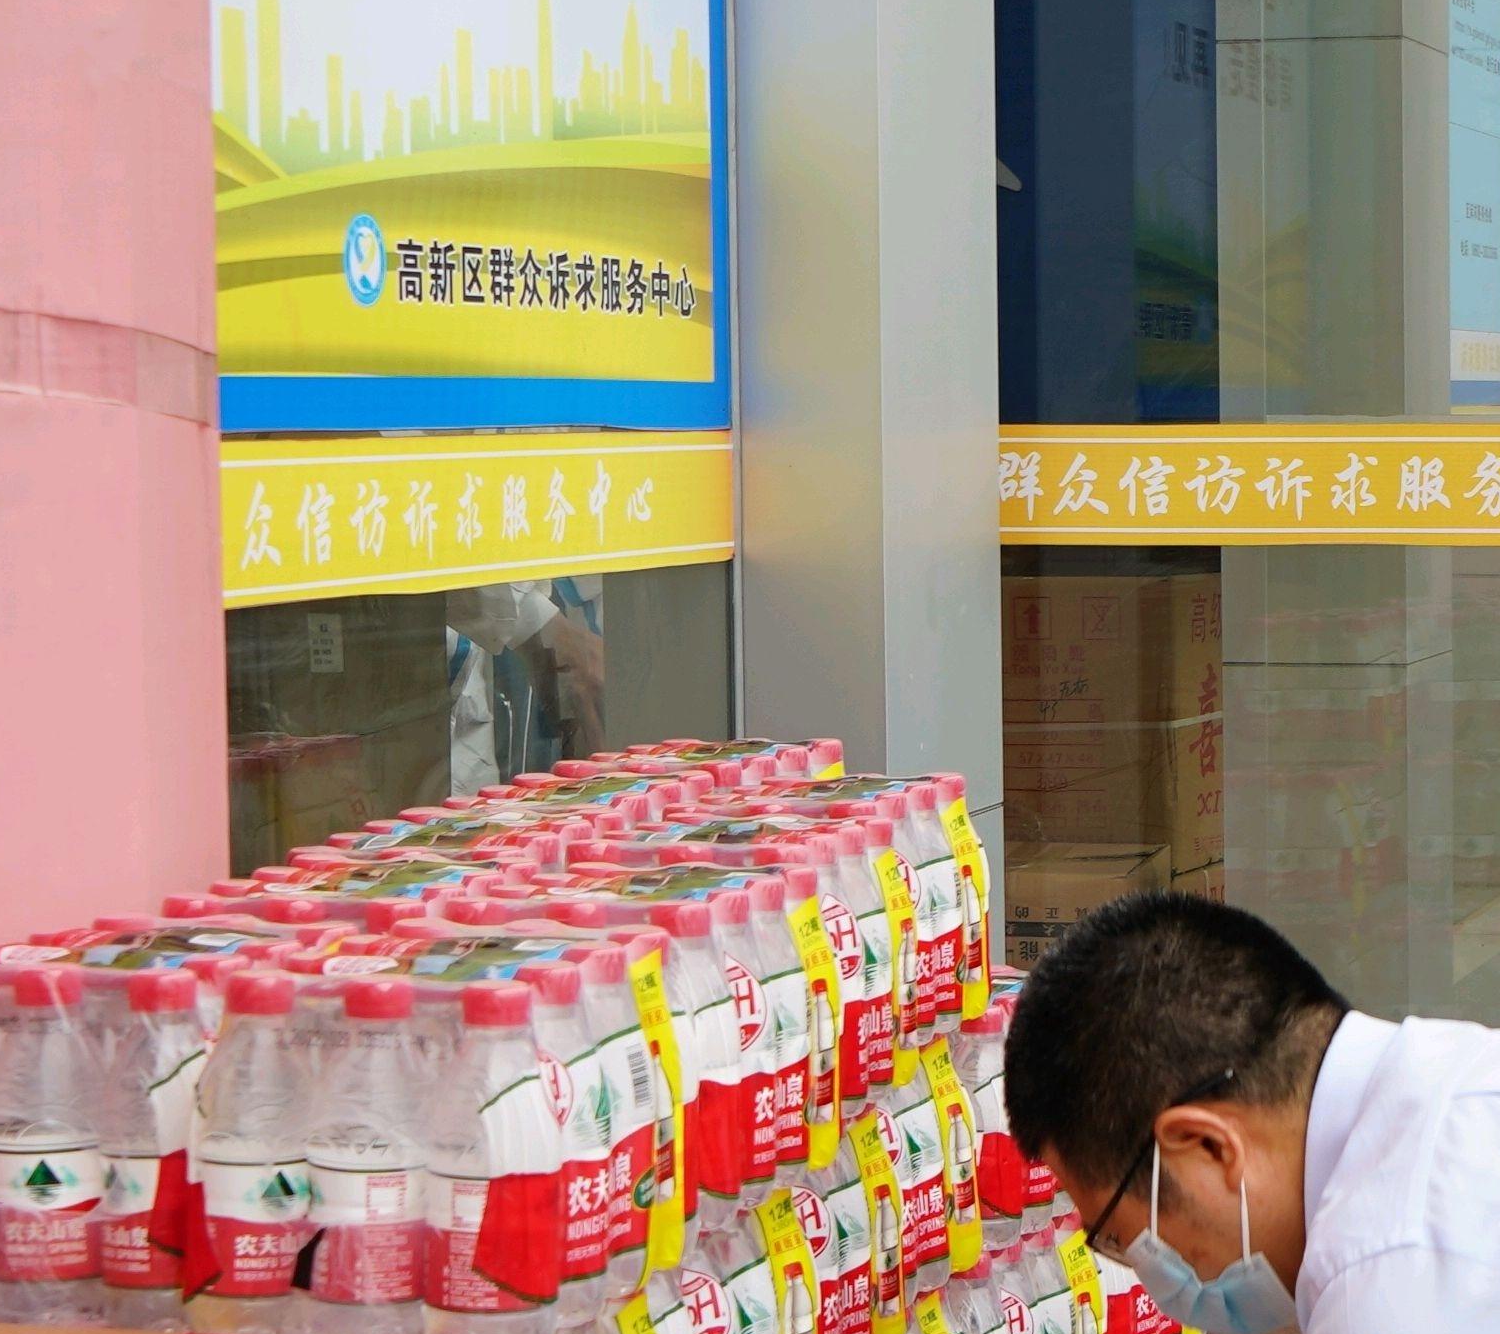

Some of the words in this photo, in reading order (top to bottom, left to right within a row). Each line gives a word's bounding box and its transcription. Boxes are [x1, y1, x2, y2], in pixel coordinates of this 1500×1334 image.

[395, 239, 698, 320] 高新区群众诉求服务中心
[239, 459, 654, 571] 众信访诉求服务中心
